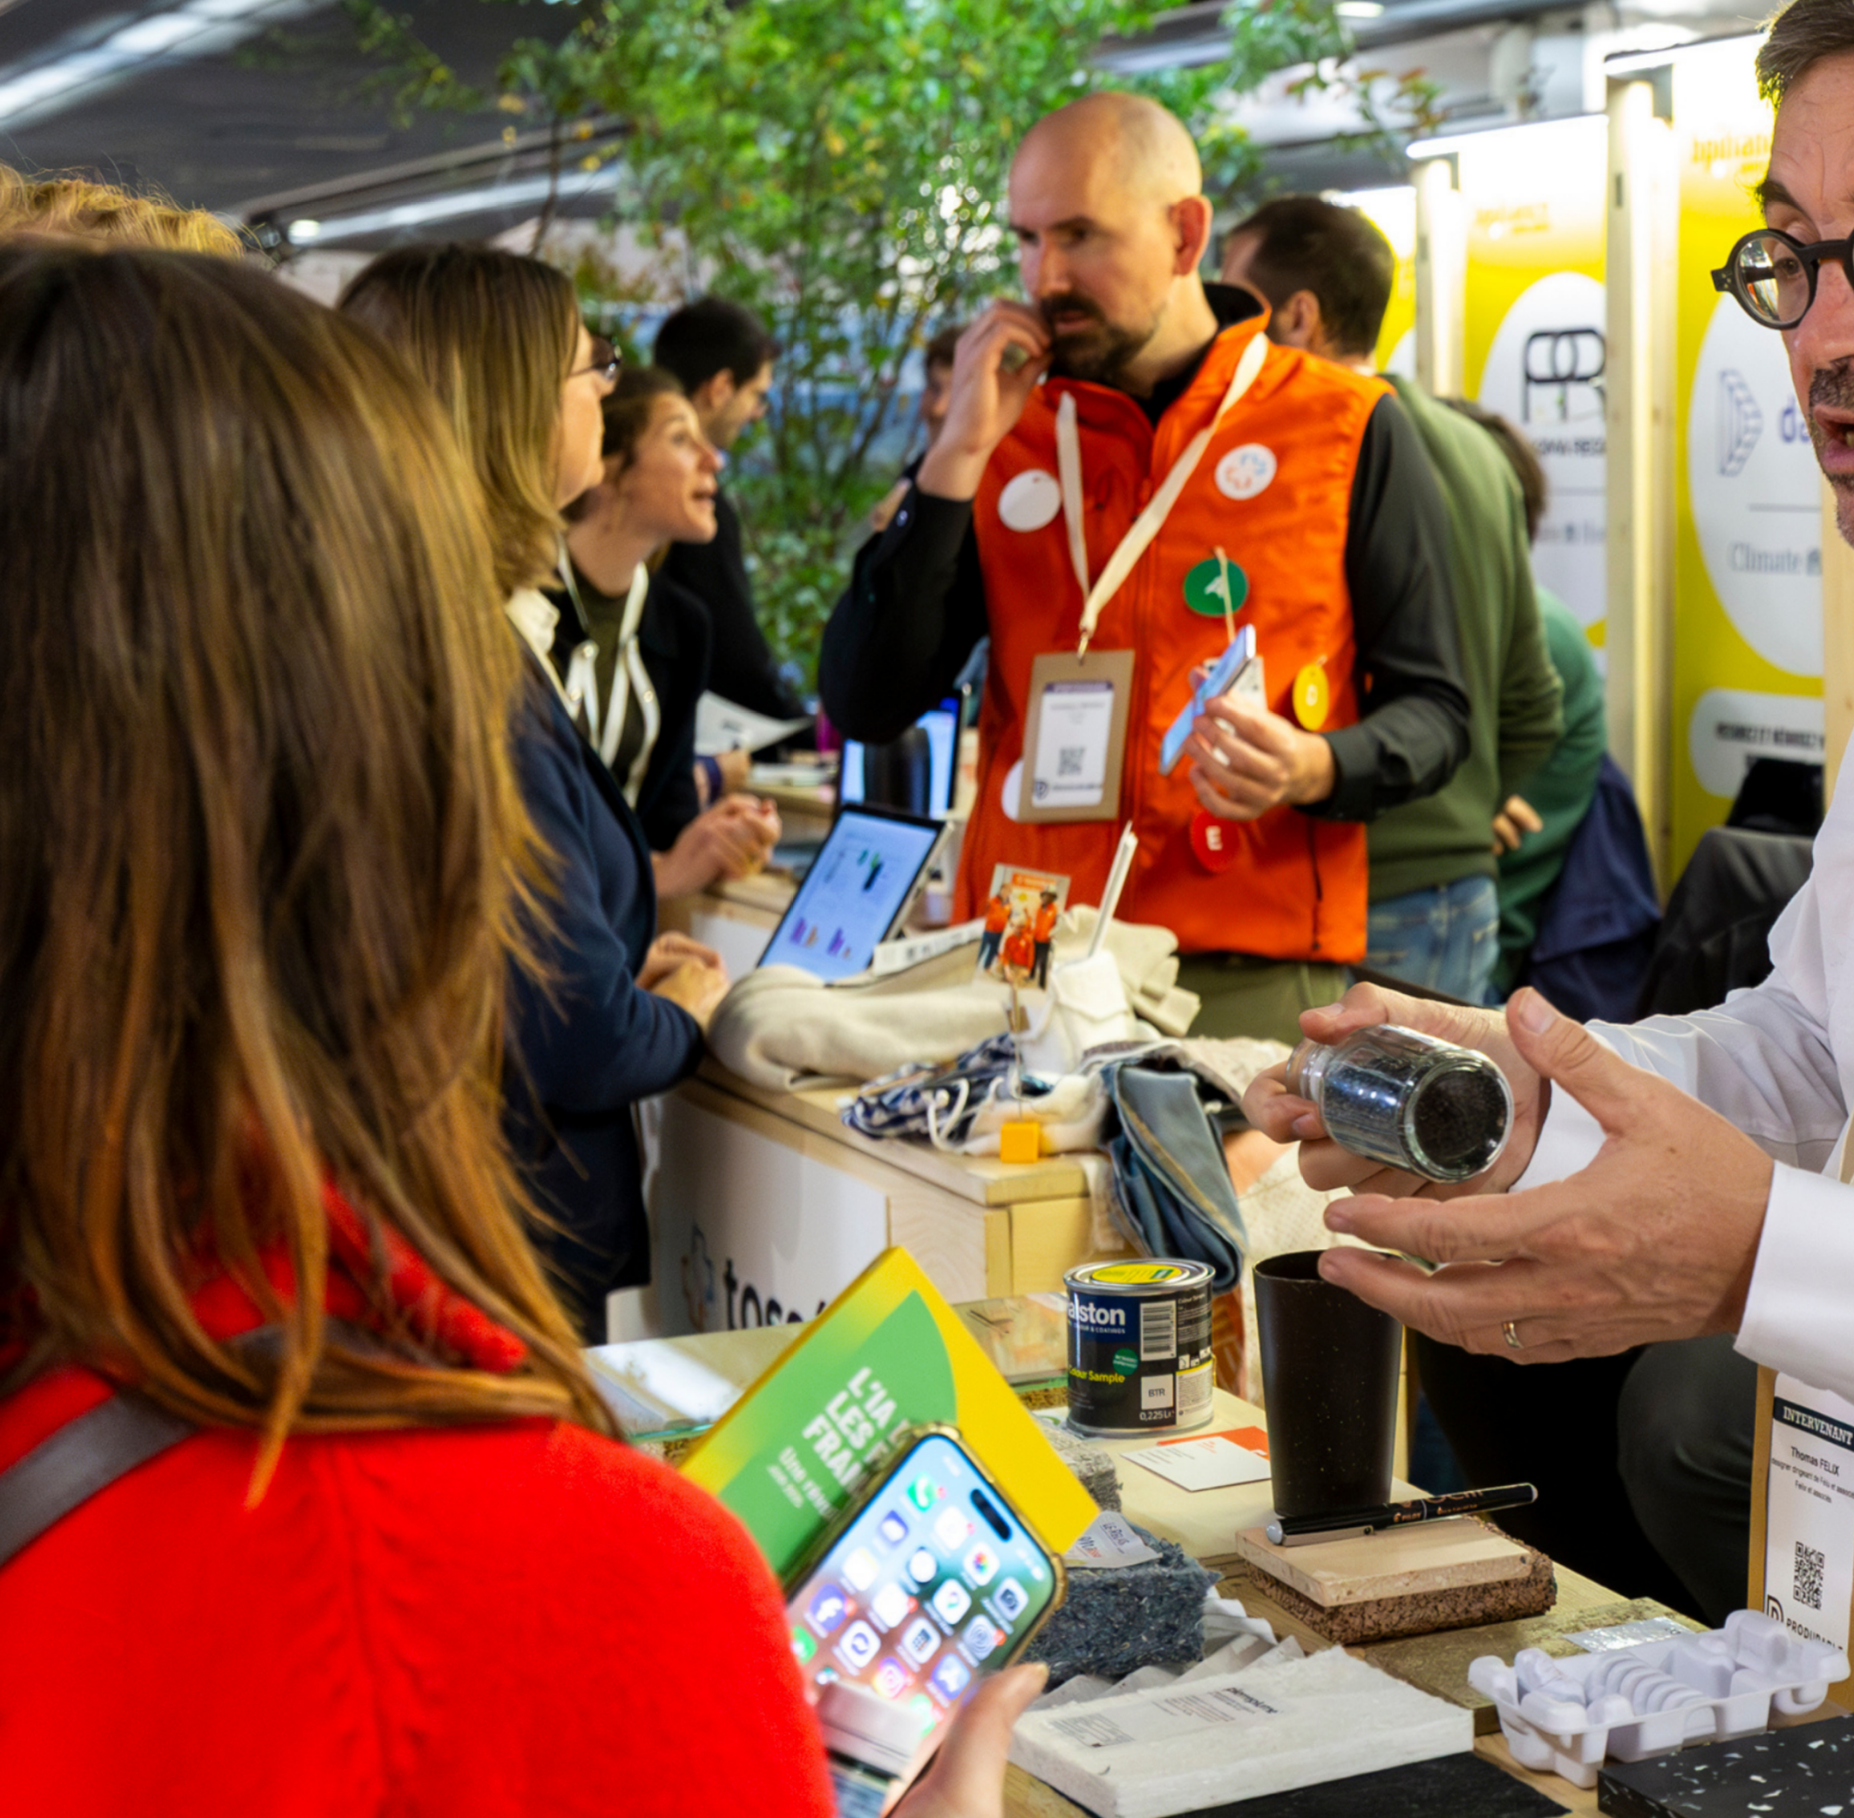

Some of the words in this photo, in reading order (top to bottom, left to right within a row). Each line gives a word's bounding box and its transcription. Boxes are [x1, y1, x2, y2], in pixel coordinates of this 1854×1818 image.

[1066, 1301, 1126, 1326] alston
[1088, 1370, 1126, 1385] Sample
[825, 1390, 875, 1450] LES
[1782, 1405, 1854, 1446] INTERVENANT
[802, 1413, 868, 1497] FRAN
[1790, 1445, 1819, 1468] Thomas
[1819, 1458, 1840, 1477] FELIX
[1786, 1617, 1844, 1651] PRODUR
